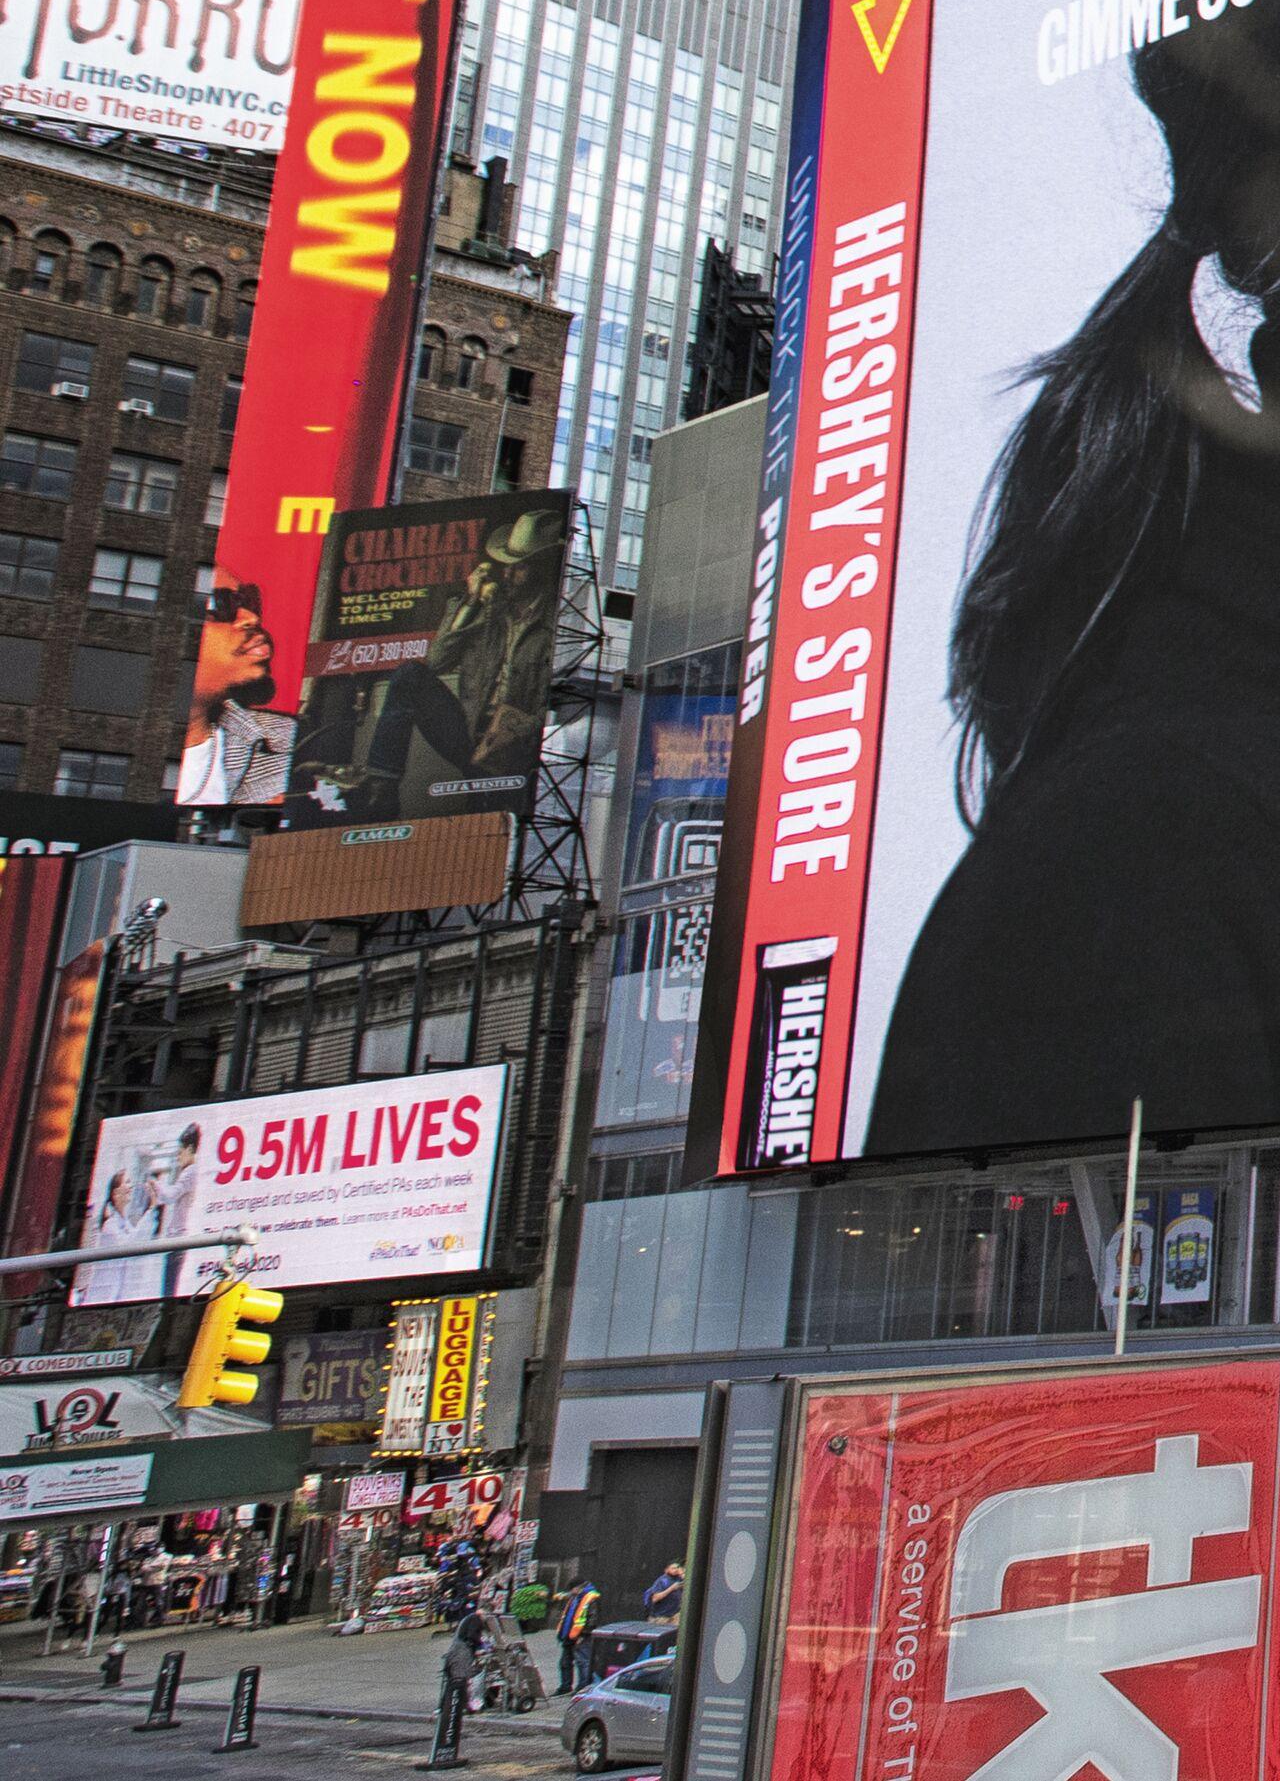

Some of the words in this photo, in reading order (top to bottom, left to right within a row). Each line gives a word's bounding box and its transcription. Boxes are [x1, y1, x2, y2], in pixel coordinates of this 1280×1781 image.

[99, 96, 203, 133] Theatre
[223, 116, 274, 143] 407
[290, 31, 422, 295] NOW
[801, 202, 906, 610] HERSHEY'S
[764, 377, 795, 492] THE
[338, 611, 394, 625] TIMES
[339, 605, 363, 615] TO
[366, 599, 414, 612] HARD
[341, 588, 429, 604] WELCOME
[740, 496, 783, 725] POWER
[771, 627, 872, 884] STORE
[346, 827, 408, 842] LAMAR
[215, 1114, 328, 1185] 9.5M
[341, 1095, 483, 1170] LIVES
[206, 1201, 222, 1214] are
[225, 1192, 269, 1213] changed
[272, 1191, 291, 1207] and
[293, 1189, 325, 1204] saved
[327, 1187, 340, 1203] by
[415, 1175, 442, 1191] each
[444, 1171, 474, 1187] week
[301, 1357, 377, 1402] GIFTS
[440, 1301, 471, 1420] LUGGAGE
[428, 1436, 459, 1454] NY
[432, 1423, 441, 1439] I
[413, 1483, 452, 1510] 4
[459, 1475, 502, 1505] 10
[907, 1503, 931, 1527] a
[892, 1539, 928, 1682] service
[945, 1434, 1261, 1781] tk
[887, 1696, 918, 1734] of
